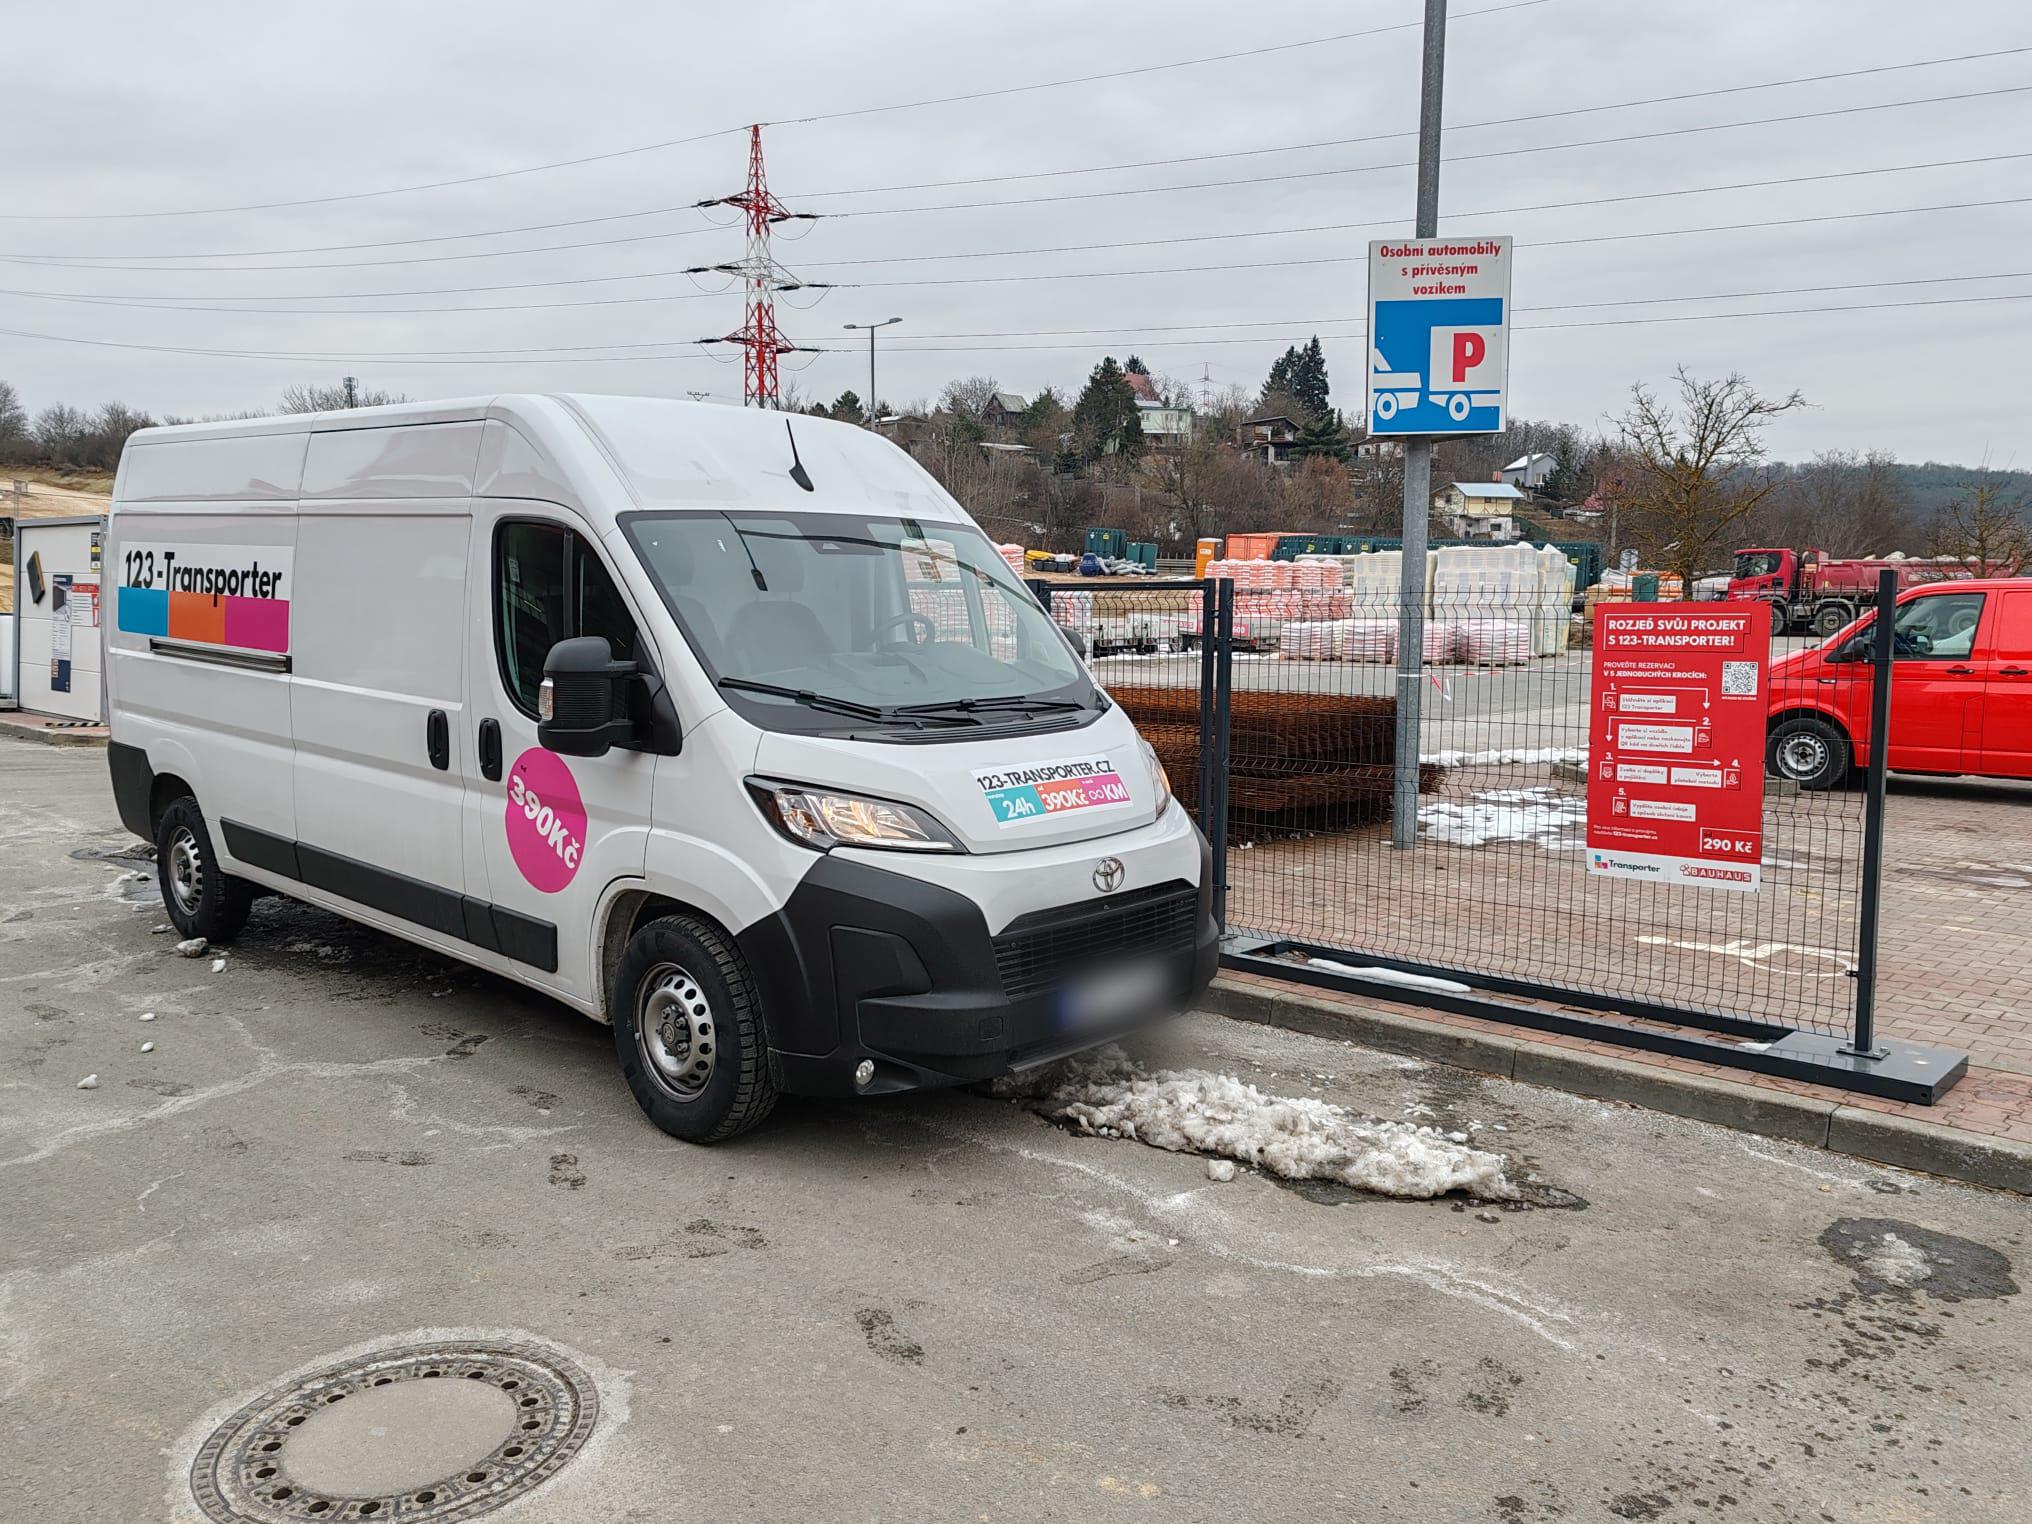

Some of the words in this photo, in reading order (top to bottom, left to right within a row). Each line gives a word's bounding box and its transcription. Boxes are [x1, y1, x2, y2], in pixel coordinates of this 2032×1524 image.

[1428, 241, 1501, 257] automobily
[1401, 267, 1408, 276] s
[1453, 333, 1486, 382] P
[1608, 618, 1654, 630] ROZJEĎ
[1658, 617, 1688, 630] SVŮJ
[1691, 619, 1746, 630] PROJEKT
[1608, 635, 1616, 645] S
[1618, 635, 1735, 646] 123-TRANSPORTER!
[1616, 670, 1671, 679] JEDNODUCHÝCH
[1672, 671, 1707, 679] KROCÍCH:
[977, 760, 1116, 790] 123-TRANSPORTER.CZ
[1041, 788, 1090, 811] 390Kč
[1002, 797, 1037, 819] 24h
[509, 775, 581, 869] 390Kč
[1703, 838, 1732, 851] 290
[1735, 840, 1753, 853] Kč
[1609, 859, 1661, 872] Transporter
[1691, 868, 1751, 882] BAUHAUS
